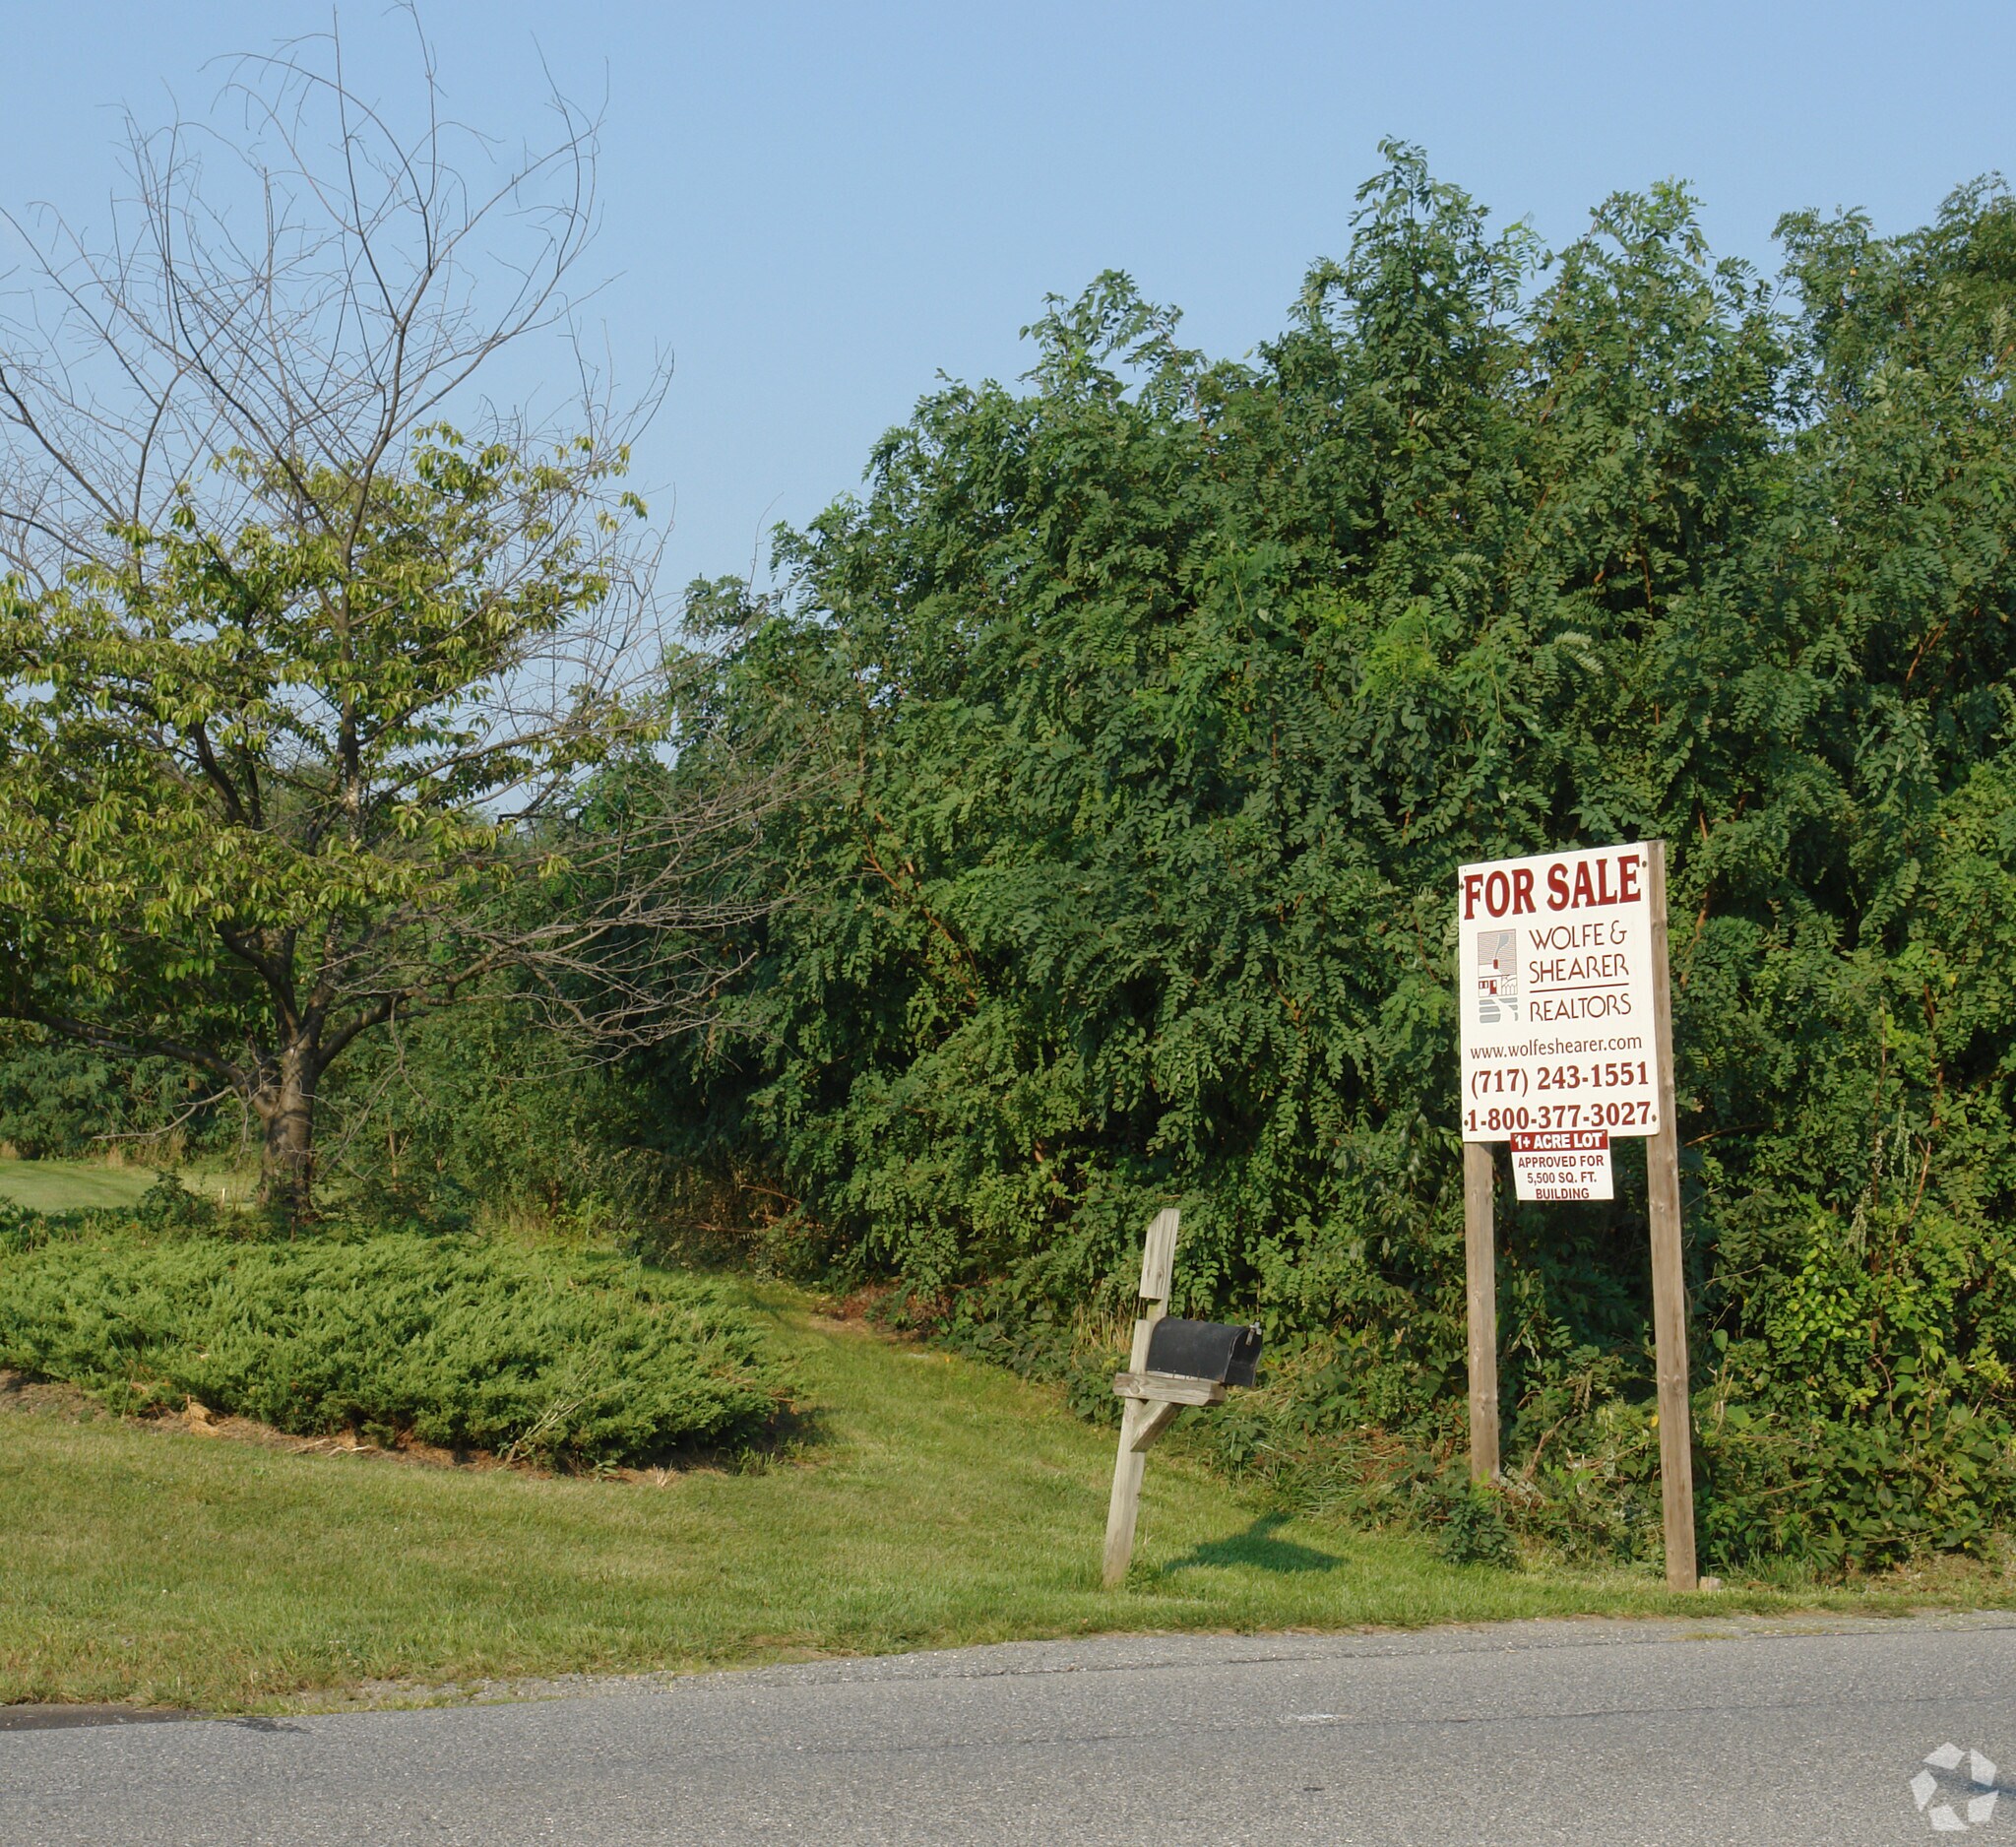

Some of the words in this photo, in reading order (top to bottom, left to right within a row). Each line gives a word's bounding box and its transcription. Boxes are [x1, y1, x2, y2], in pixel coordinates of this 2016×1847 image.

[1464, 868, 1537, 920] FOR
[1546, 855, 1641, 912] SALE
[1529, 923, 1605, 950] WOLFE
[1609, 920, 1627, 945] &
[1529, 953, 1629, 985] SHEARER
[1530, 992, 1632, 1022] REALTORS
[1470, 1036, 1642, 1059] www.wolfeshearer.com
[1471, 1067, 1529, 1100] (717)
[1537, 1060, 1649, 1090] 243-1551
[1468, 1101, 1651, 1132] 1-800-377-3027
[1515, 1134, 1531, 1149] 1+
[1533, 1133, 1571, 1150] ACRE
[1573, 1132, 1603, 1148] LOT
[1518, 1156, 1577, 1169] APPROVED
[1580, 1155, 1605, 1167] FOR
[1527, 1172, 1555, 1186] 5,500
[1558, 1172, 1578, 1183] SQ.
[1580, 1171, 1598, 1182] FT.
[1536, 1187, 1590, 1199] BUILDING
